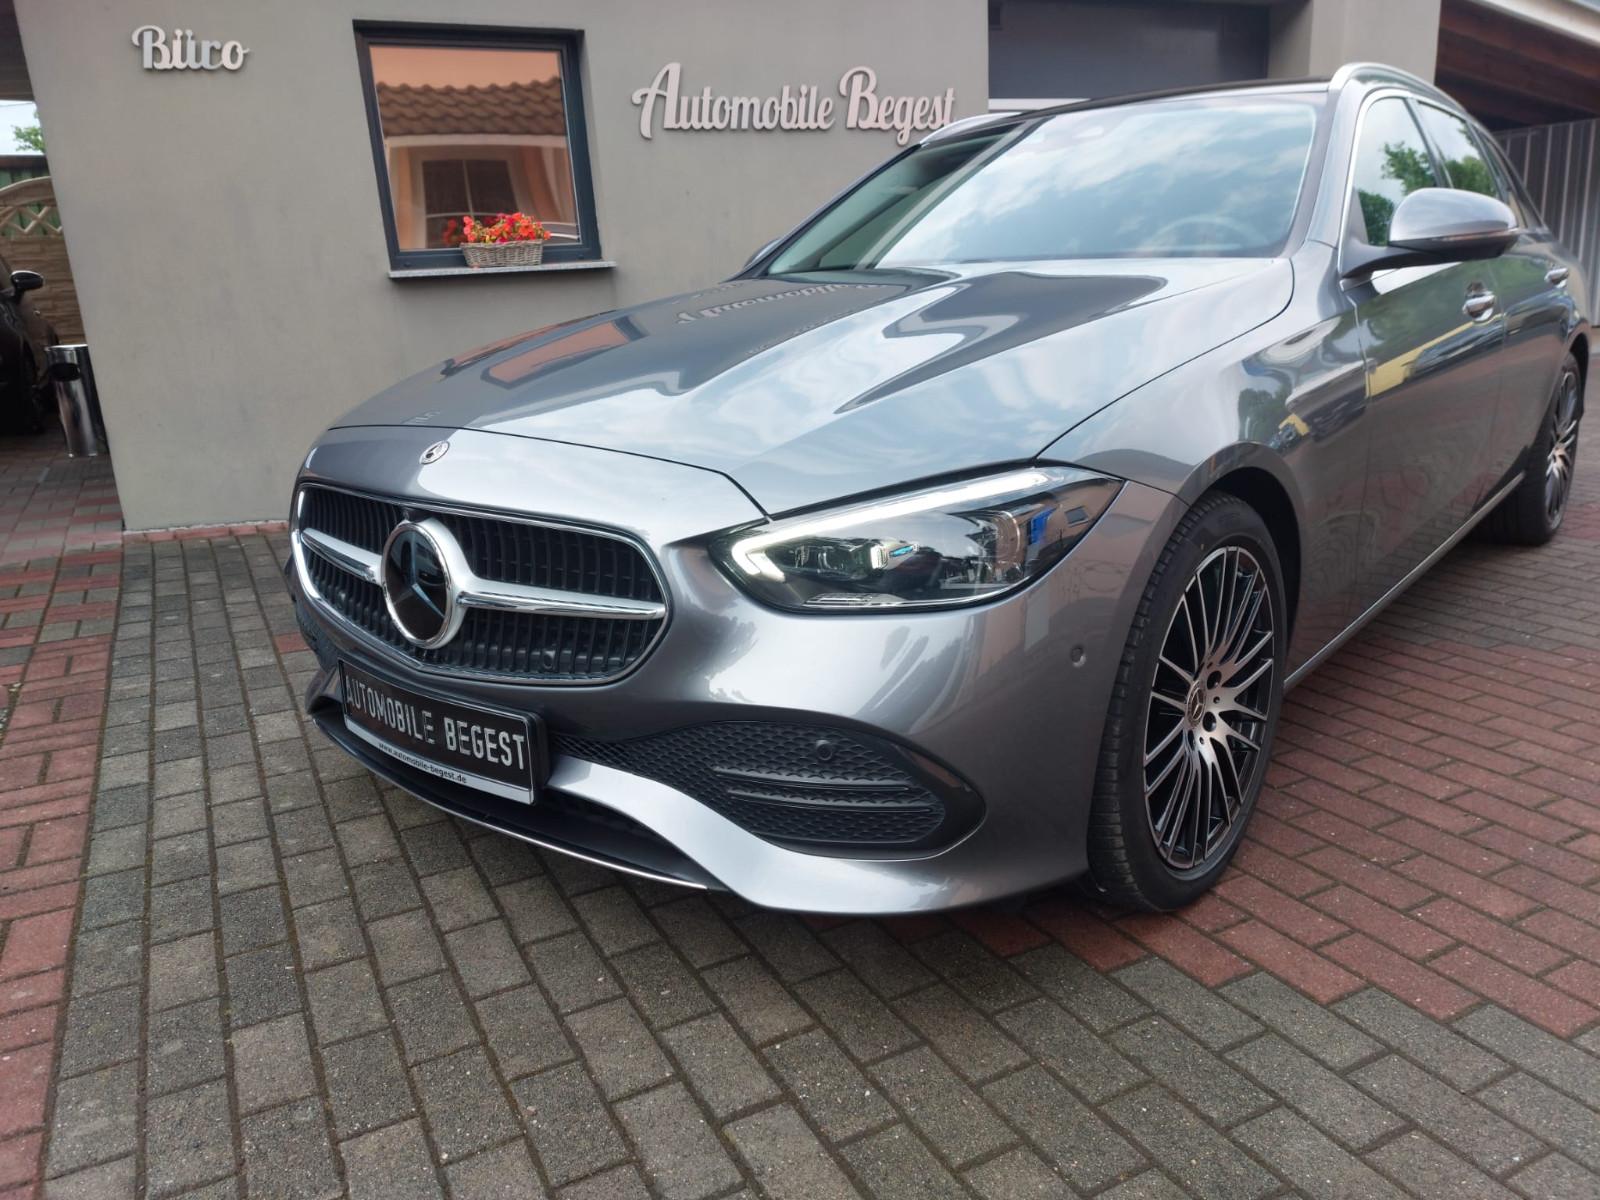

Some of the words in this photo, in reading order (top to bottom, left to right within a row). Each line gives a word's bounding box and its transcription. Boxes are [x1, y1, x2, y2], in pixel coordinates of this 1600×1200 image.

[131, 25, 249, 70] Büro
[632, 63, 834, 139] Automobile
[840, 67, 954, 145] Begest
[345, 675, 435, 744] AUTOMOBILE
[443, 717, 524, 770] BEGEST
[378, 742, 467, 783] www.automobile-begest.de
